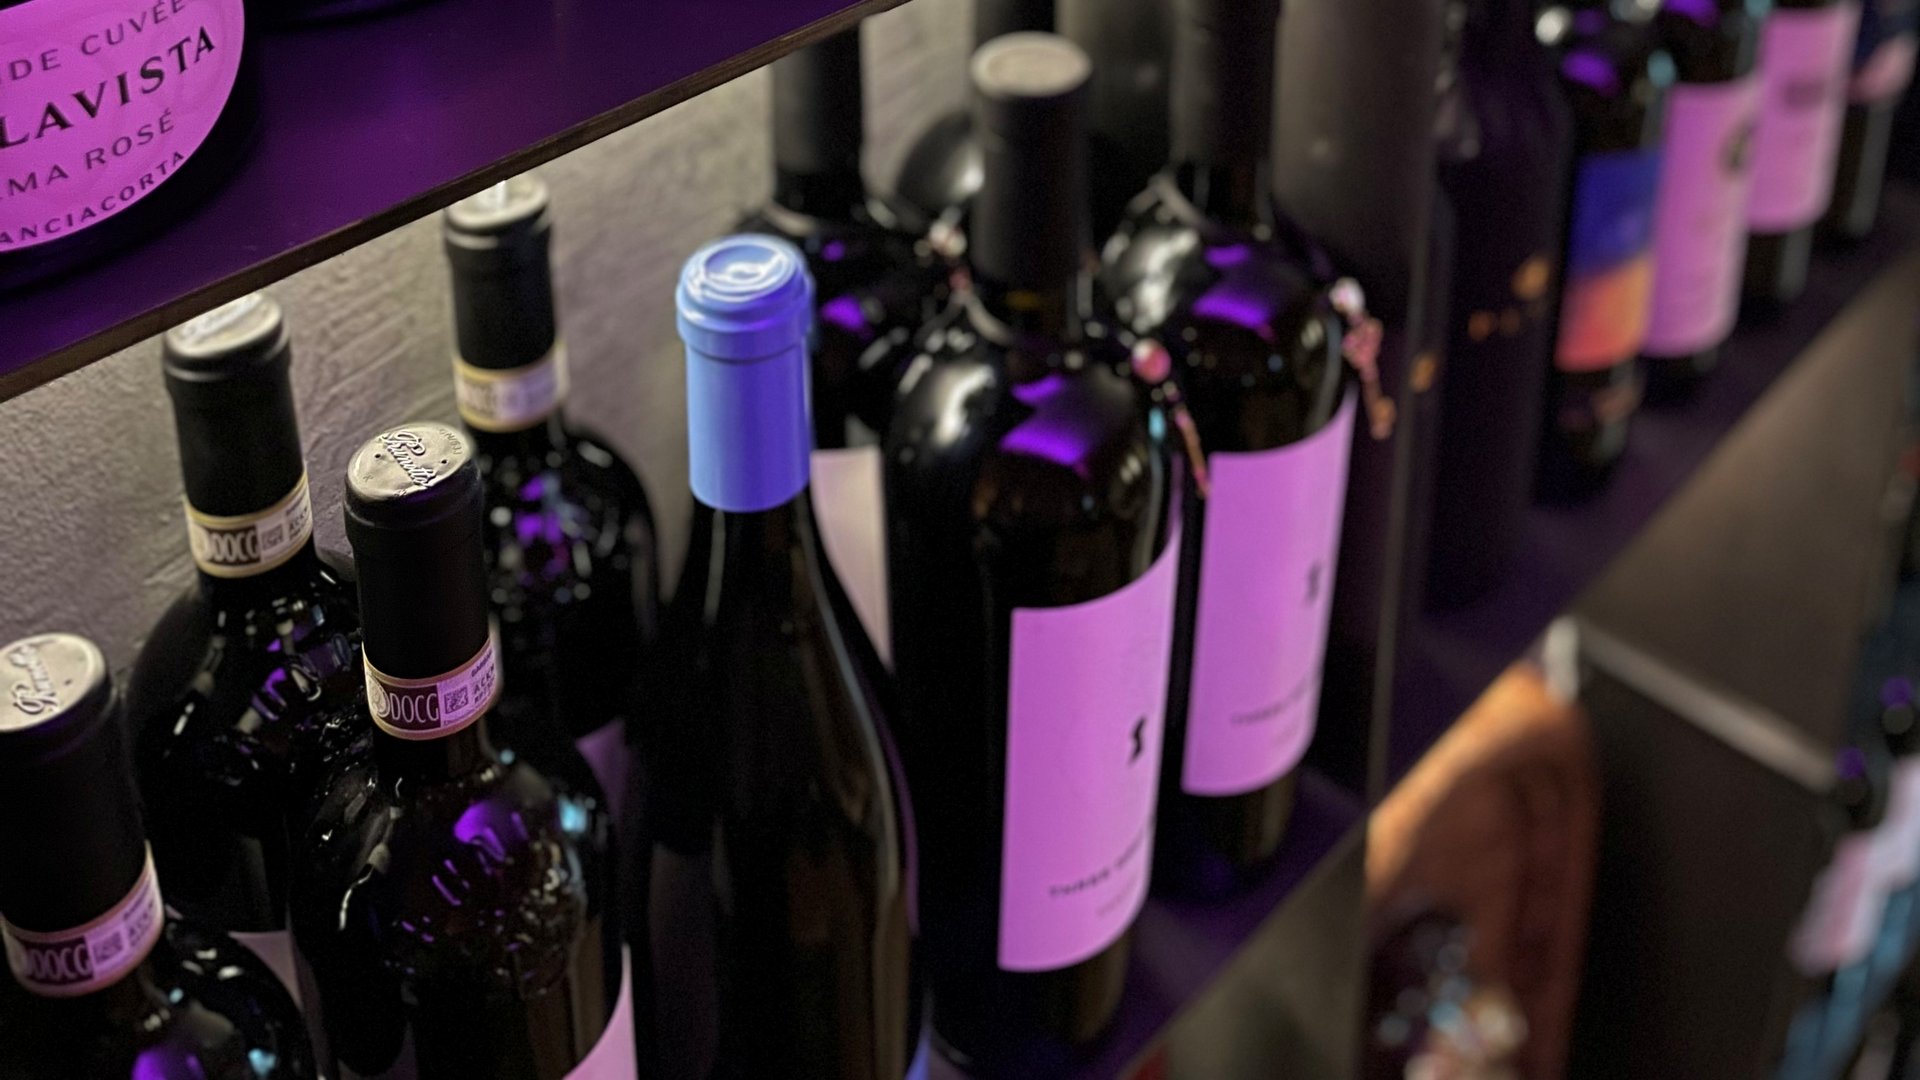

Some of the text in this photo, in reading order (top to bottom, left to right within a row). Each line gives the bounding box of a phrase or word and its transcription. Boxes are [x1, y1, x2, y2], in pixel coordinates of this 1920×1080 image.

[0, 25, 216, 150] LAVISTA
[8, 107, 175, 196] MA ROSÉ
[0, 151, 185, 244] ANCIACORTA
[389, 692, 440, 724] DOCG
